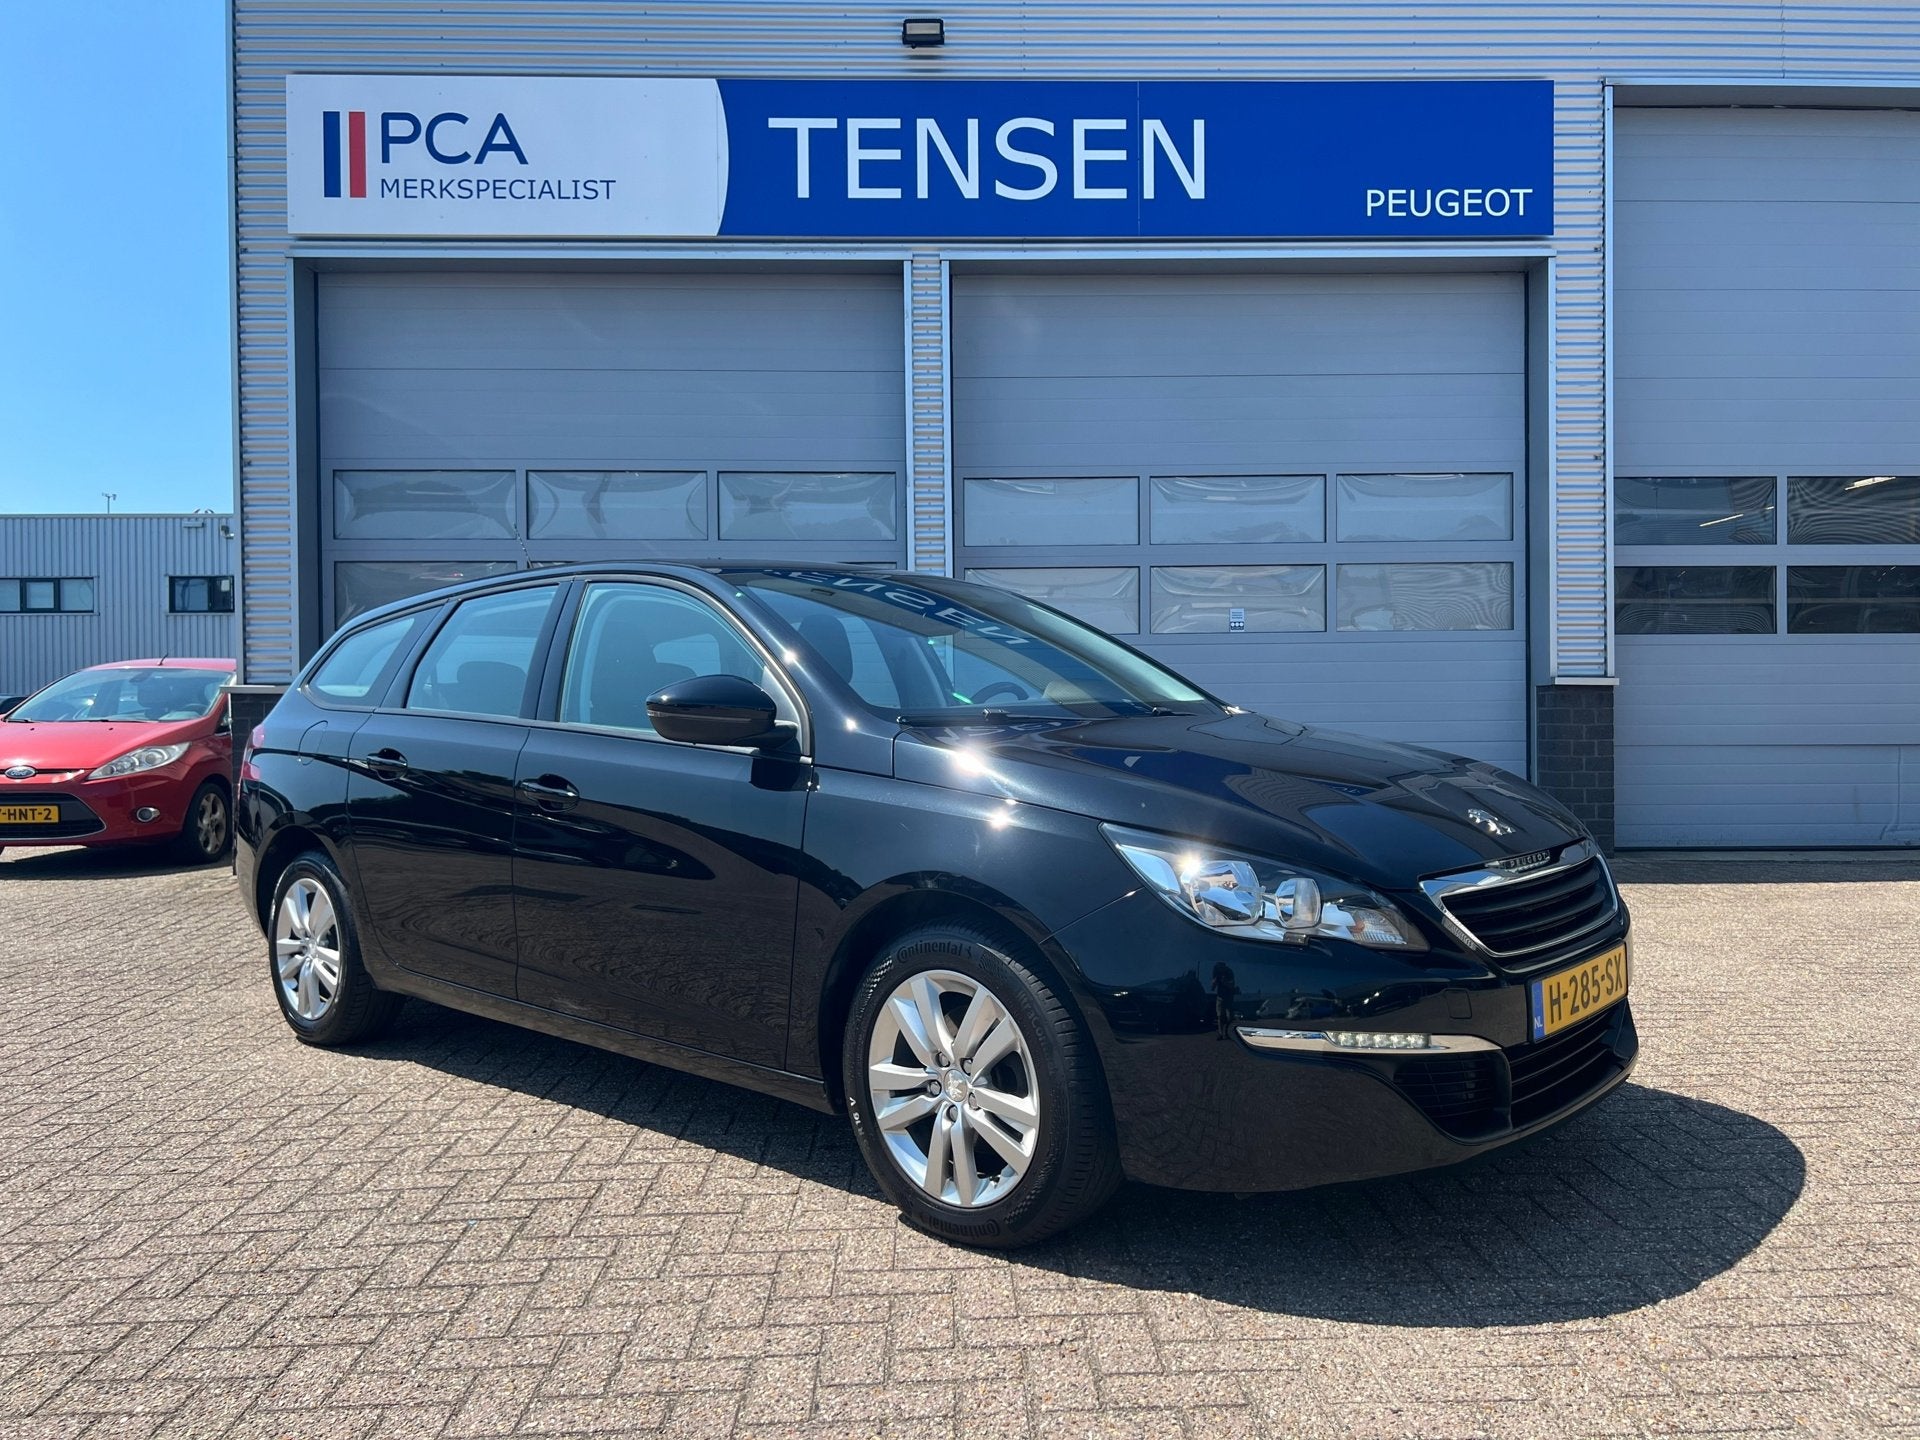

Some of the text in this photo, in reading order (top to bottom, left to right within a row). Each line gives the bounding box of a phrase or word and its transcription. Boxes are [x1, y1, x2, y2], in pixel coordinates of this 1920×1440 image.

[380, 111, 529, 165] PCA
[768, 116, 1207, 201] TENSEN
[380, 178, 617, 200] MERKSPECIALIST
[1366, 187, 1533, 219] PEUGEOT
[1509, 852, 1547, 868] PEUGEOT
[896, 940, 963, 963] Continental
[1549, 952, 1624, 1025] H-285-SX
[1534, 1015, 1544, 1030] NL
